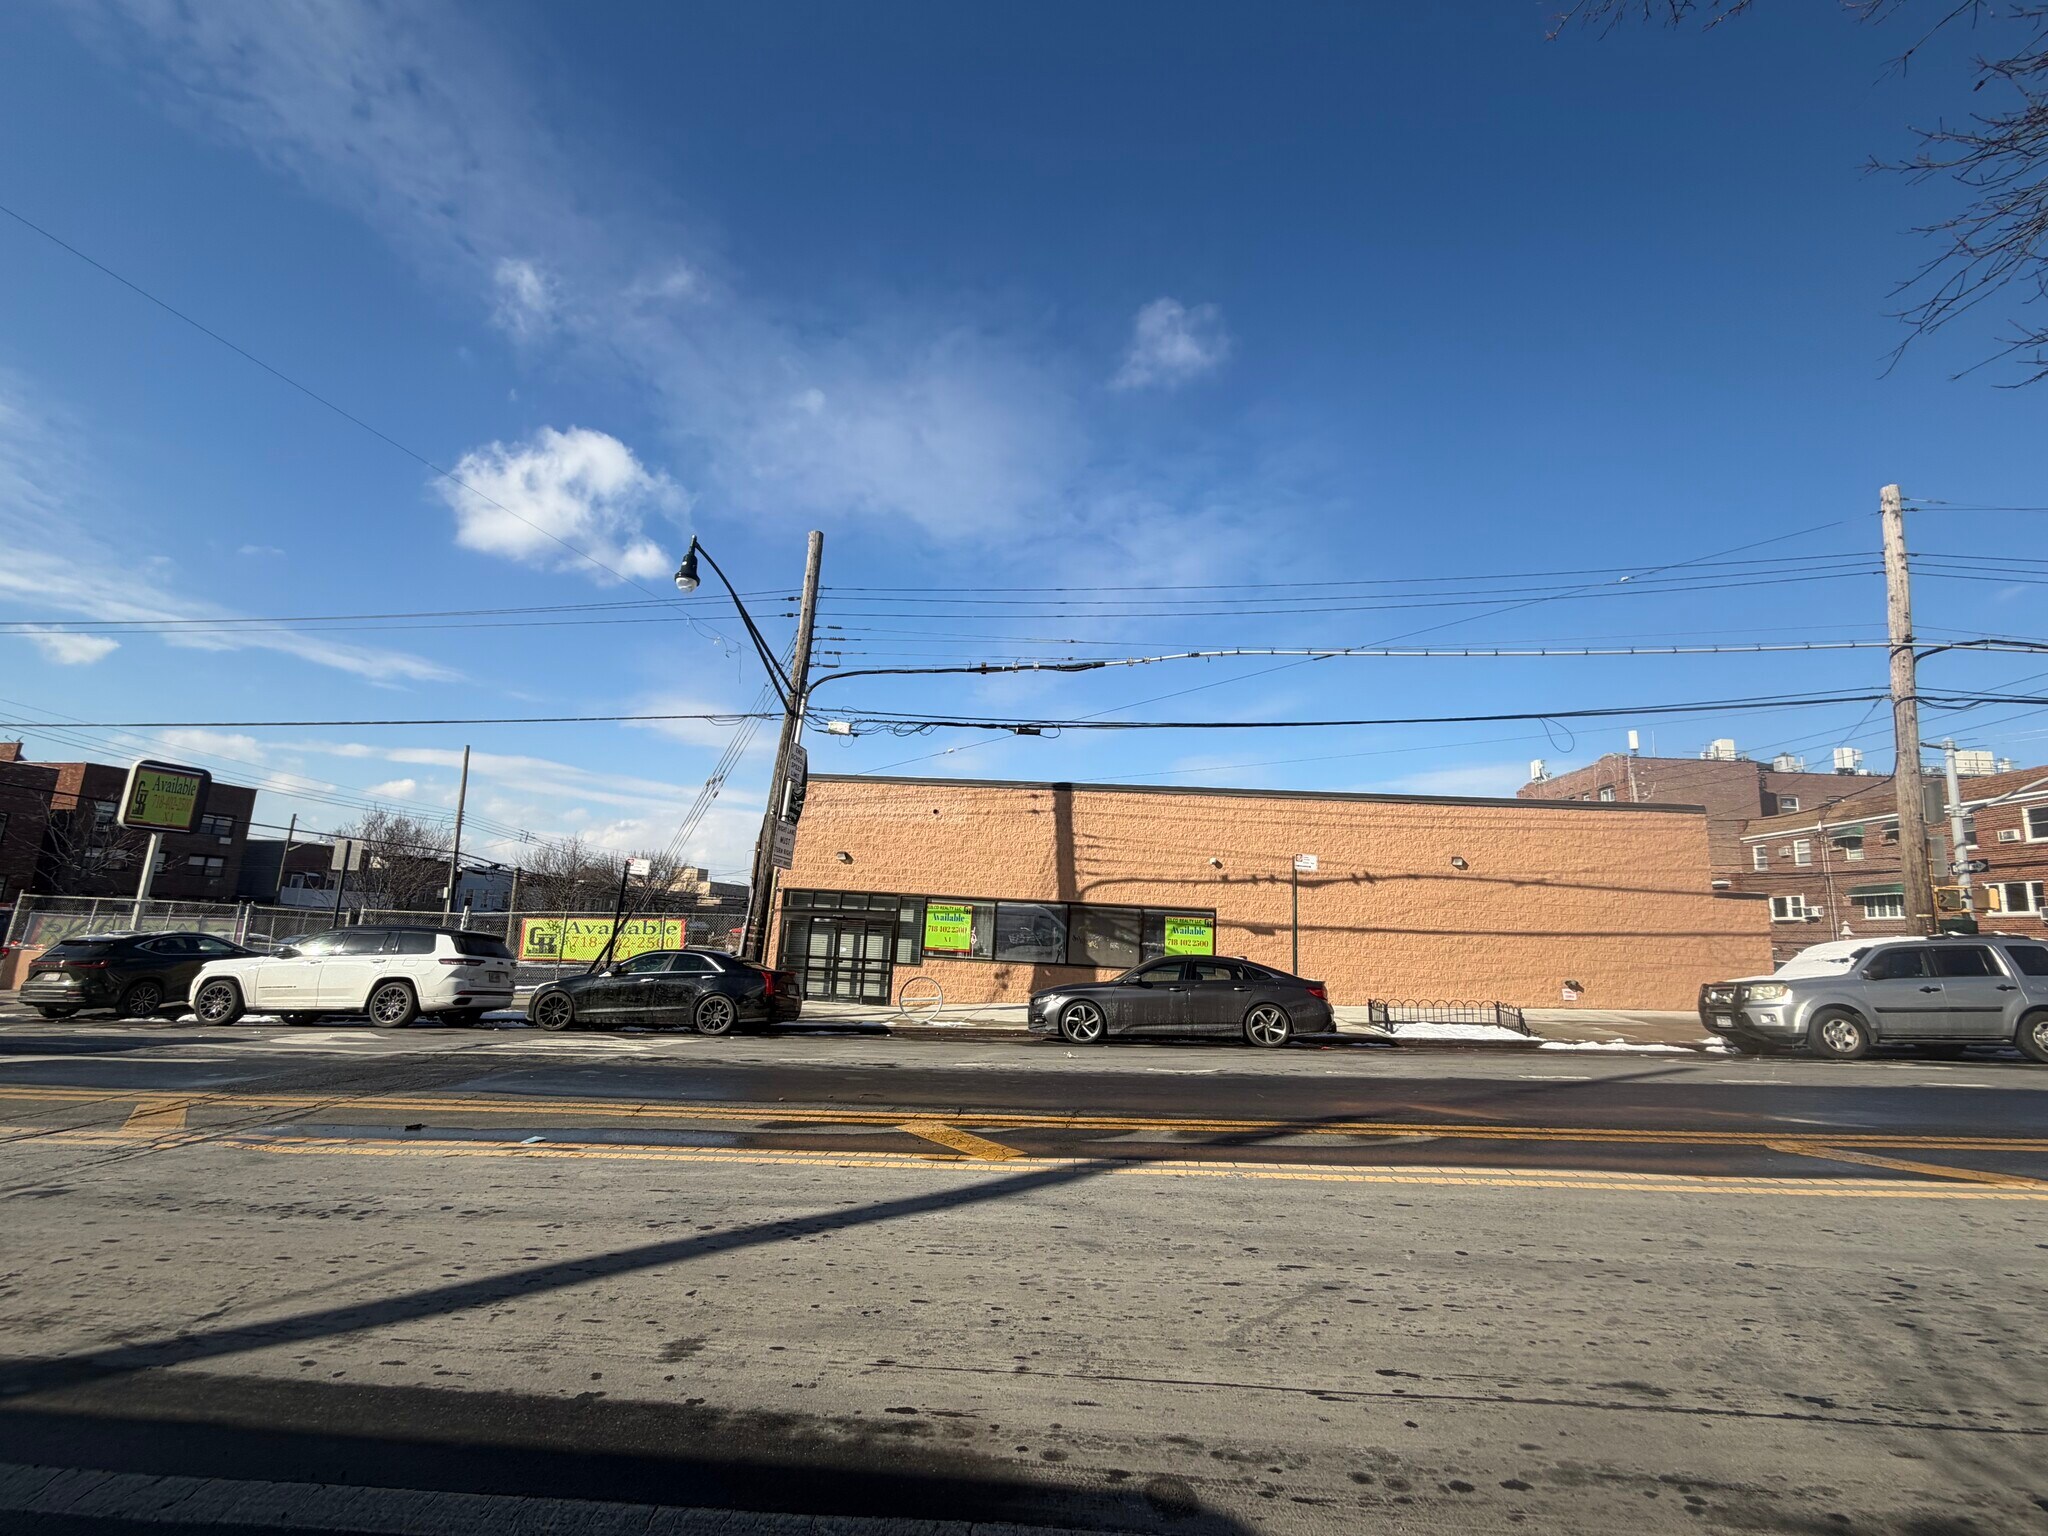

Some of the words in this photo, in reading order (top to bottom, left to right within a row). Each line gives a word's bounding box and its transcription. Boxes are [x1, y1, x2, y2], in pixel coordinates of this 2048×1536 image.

[795, 747, 803, 756] END
[791, 753, 805, 766] SCHOOL
[791, 761, 802, 773] SPEED
[790, 770, 800, 780] LIMIT
[151, 775, 197, 796] Available
[780, 836, 791, 845] MUST
[933, 913, 965, 921] Available
[1172, 926, 1206, 935] Available
[1180, 939, 1191, 947] 402
[1193, 940, 1209, 948] 2500
